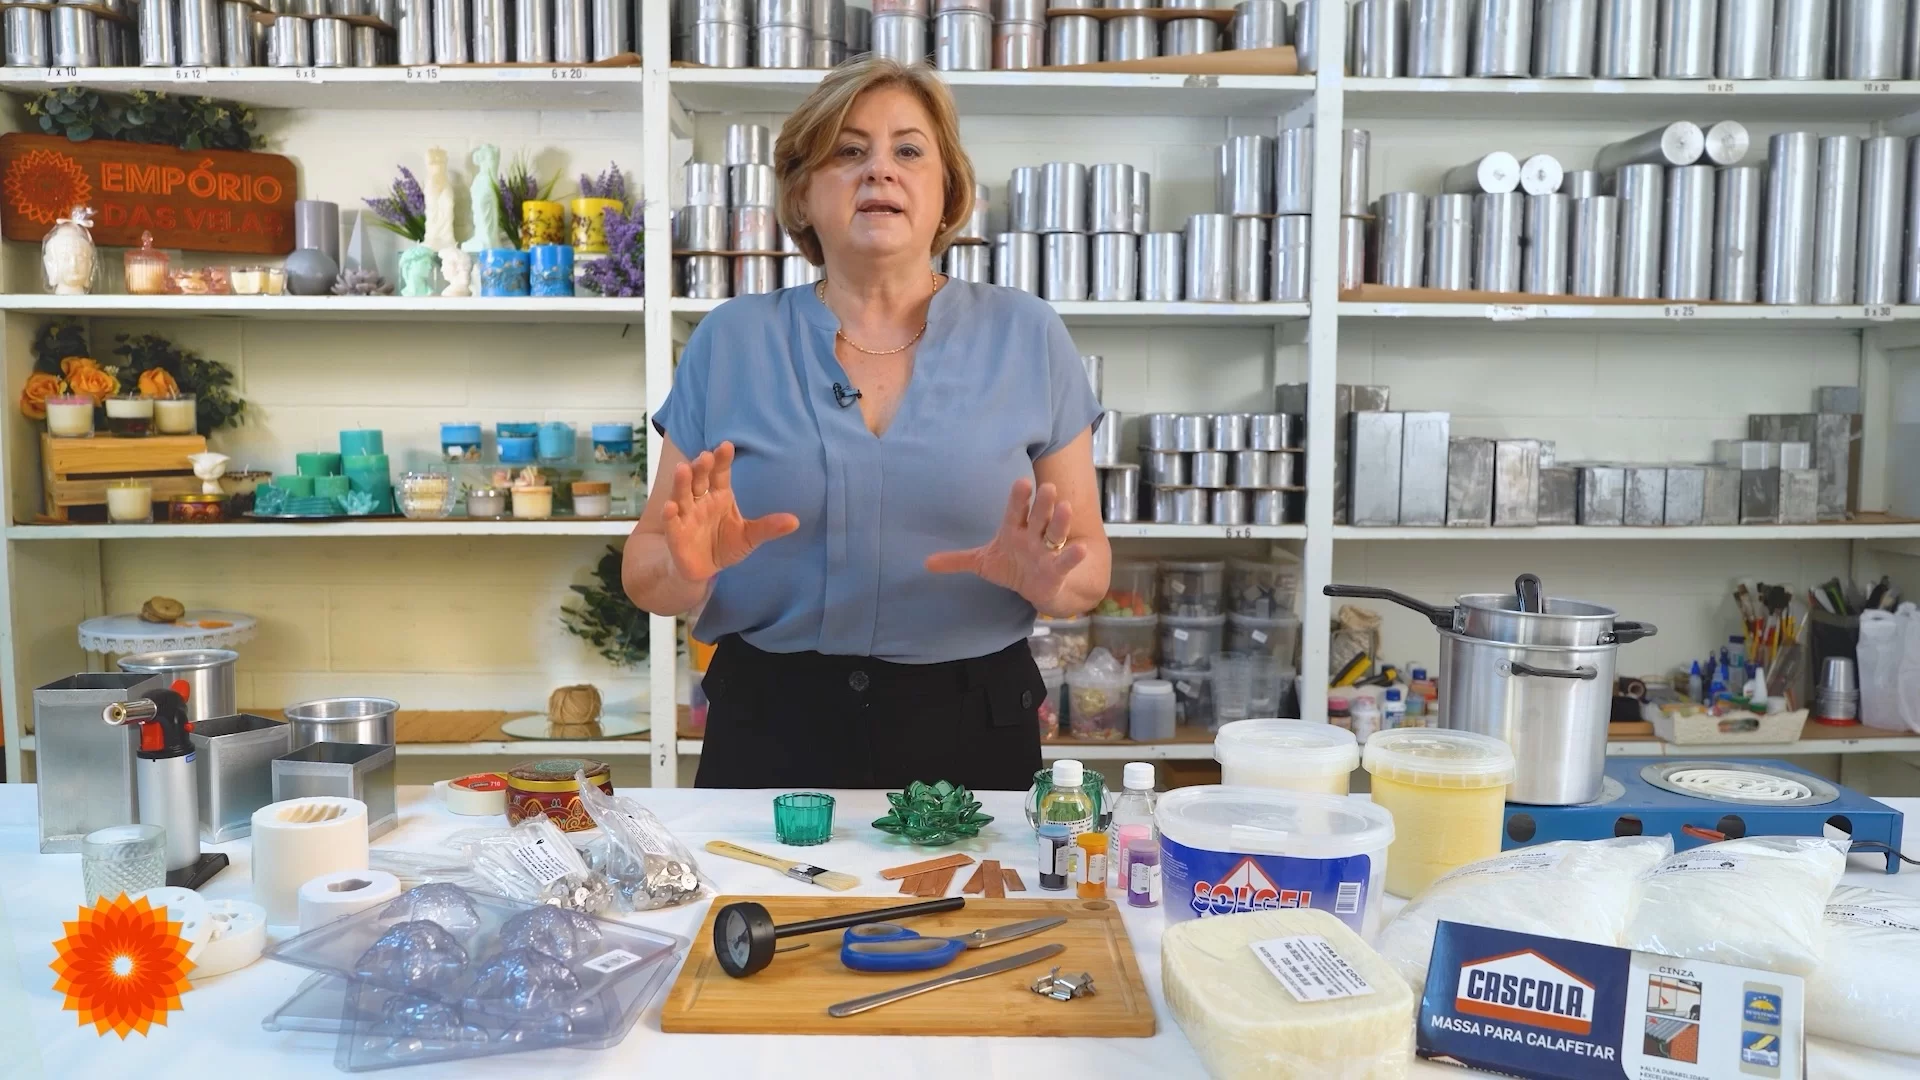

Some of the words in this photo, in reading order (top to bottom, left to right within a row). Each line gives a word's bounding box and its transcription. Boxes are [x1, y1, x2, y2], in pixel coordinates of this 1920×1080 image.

[55, 69, 62, 77] x
[66, 67, 77, 77] 10
[176, 69, 181, 79] 6
[192, 69, 200, 79] 12
[296, 69, 300, 78] 6
[311, 69, 316, 78] 8
[407, 69, 413, 78] 6
[426, 69, 437, 78] 15
[552, 69, 558, 79] 6
[570, 69, 582, 79] 20
[1724, 84, 1734, 92] 25
[1880, 84, 1890, 92] 30
[100, 157, 282, 204] EMPÓRIO
[103, 203, 177, 230] DAS
[183, 207, 284, 236] VELAS
[1682, 307, 1694, 316] 25
[1880, 307, 1890, 316] 30
[1226, 528, 1232, 538] 6
[1244, 528, 1250, 538] 6
[1318, 942, 1339, 957] CERA
[1335, 959, 1348, 967] DE
[1344, 968, 1367, 986] COCO
[1658, 966, 1695, 978] CINZA
[1466, 969, 1584, 1018] CASCOLA
[1431, 1014, 1481, 1036] MASSA
[1484, 1026, 1523, 1044] PARA
[1526, 1032, 1615, 1062] CALAFETAR
[1661, 1069, 1710, 1080] DURABILIDADE
